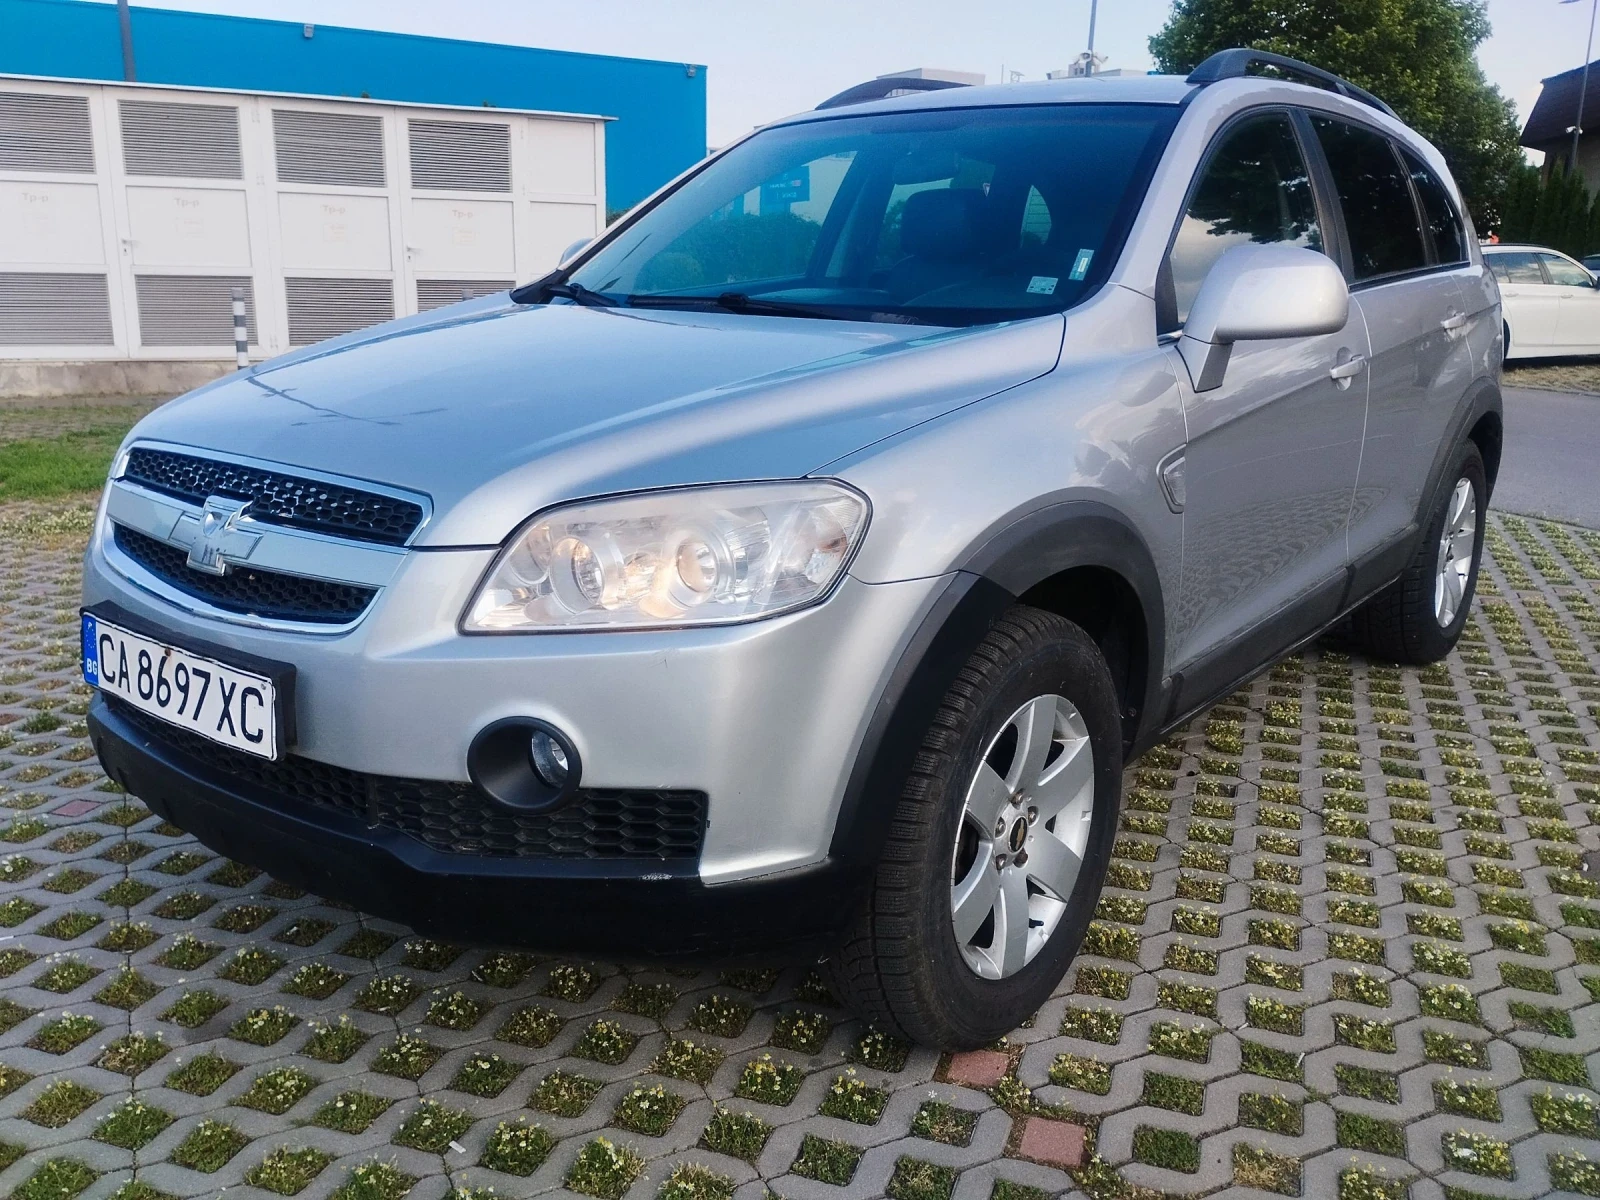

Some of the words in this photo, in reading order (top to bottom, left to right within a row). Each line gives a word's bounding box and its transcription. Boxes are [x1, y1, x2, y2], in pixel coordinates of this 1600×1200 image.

[86, 658, 98, 676] BG
[100, 633, 131, 694] CA
[137, 649, 212, 721] 8697
[216, 676, 264, 744] XC
